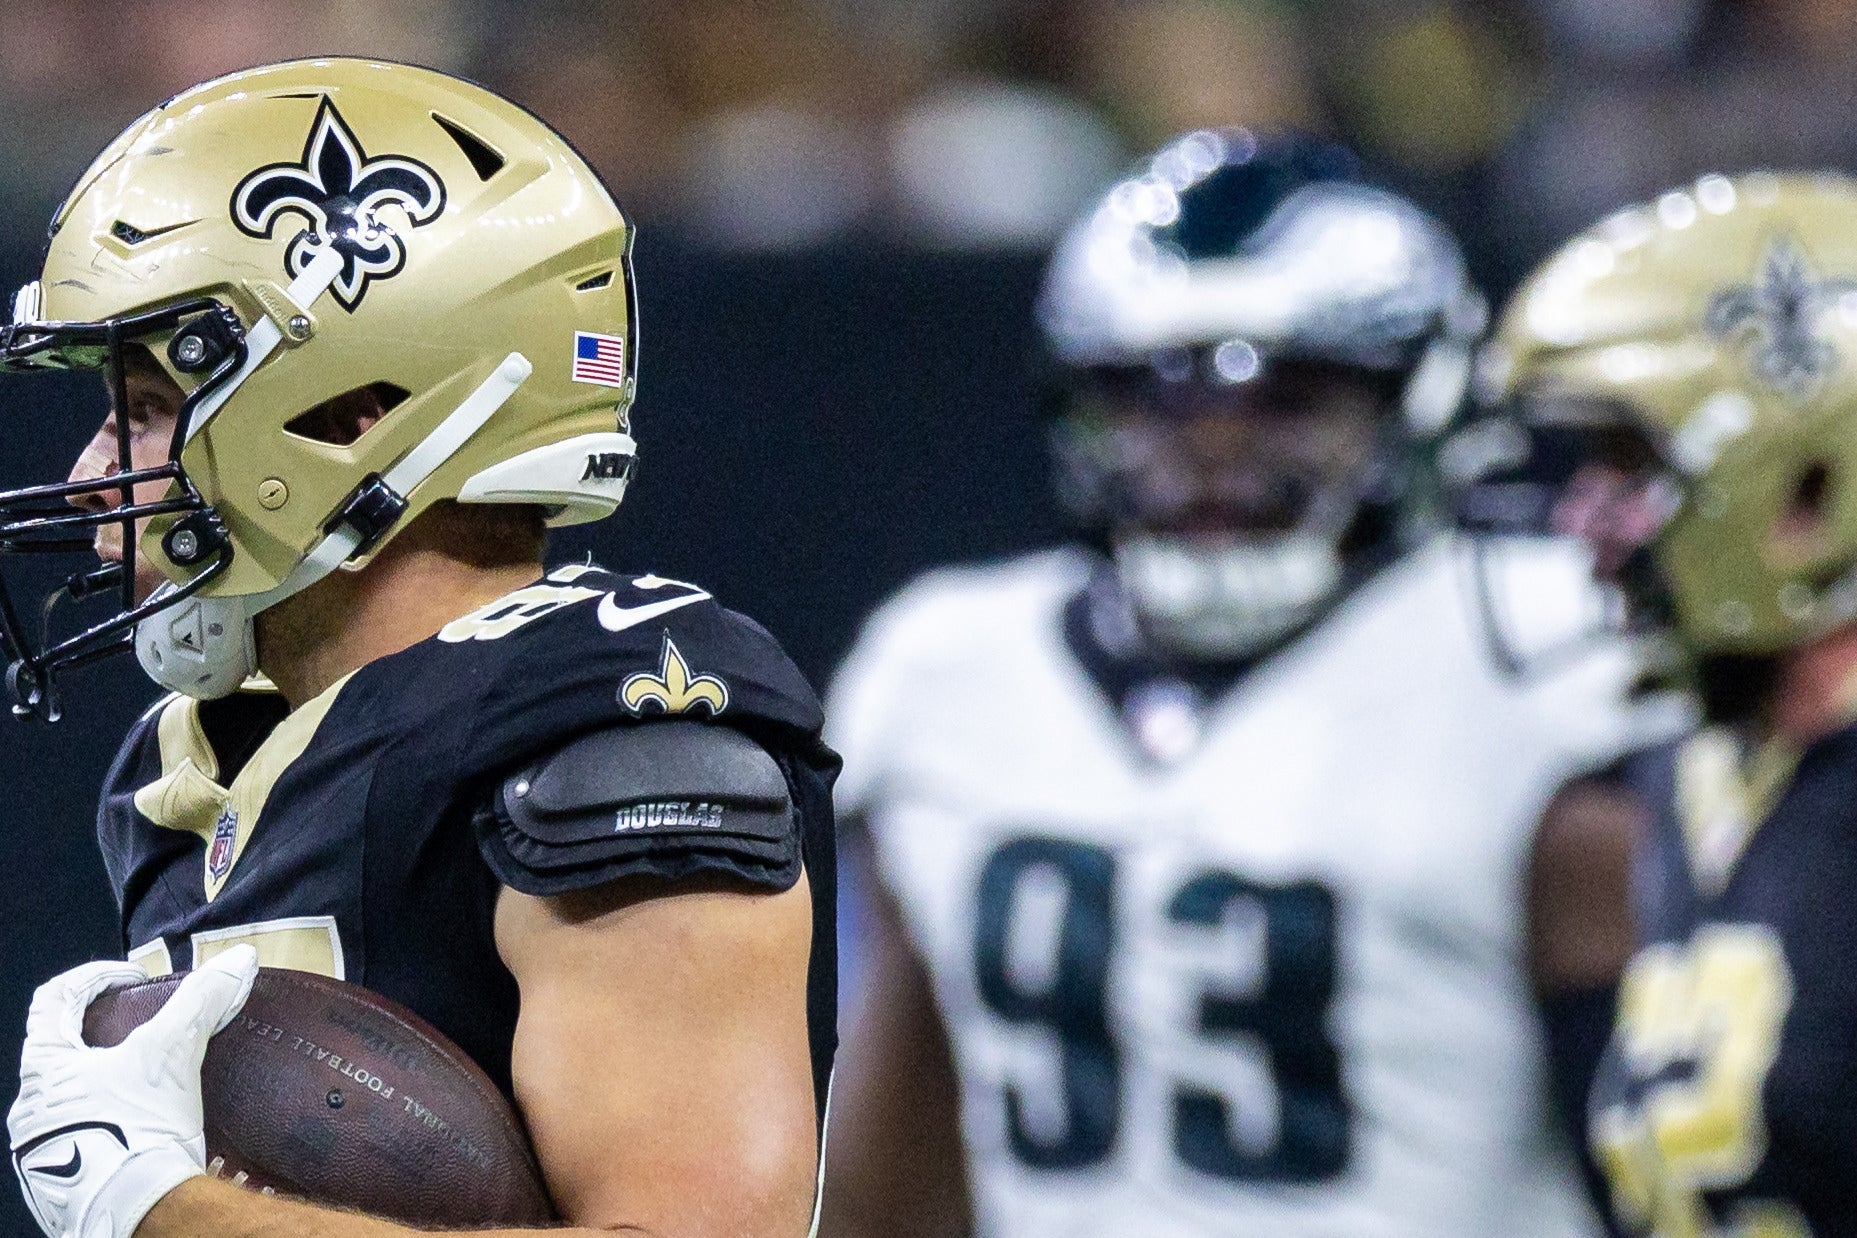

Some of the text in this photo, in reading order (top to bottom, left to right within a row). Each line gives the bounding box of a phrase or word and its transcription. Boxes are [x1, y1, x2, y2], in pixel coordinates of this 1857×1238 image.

[614, 802, 724, 832] DOUGLAS
[972, 832, 1350, 1184] 93
[294, 1036, 395, 1098] FOOTBALL
